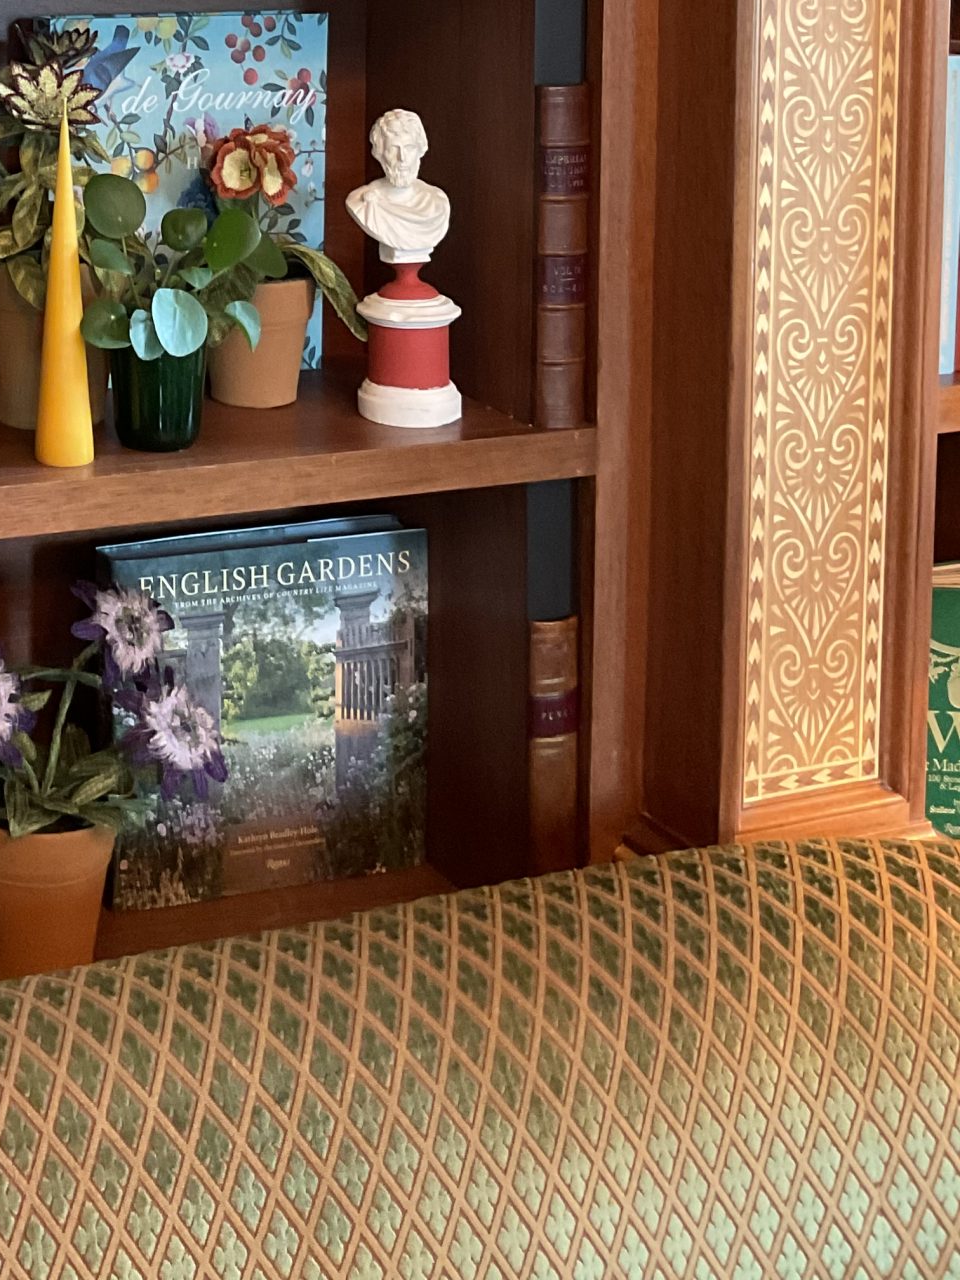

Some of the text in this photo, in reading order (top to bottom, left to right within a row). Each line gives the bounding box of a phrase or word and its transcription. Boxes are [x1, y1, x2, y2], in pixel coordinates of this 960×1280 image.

[121, 68, 317, 125] de Gournay
[139, 550, 411, 600] ENGLISH GARDENS
[174, 581, 378, 610] FROM THE ARCHIVES OF COUNTRY LIFE MAGAZINE
